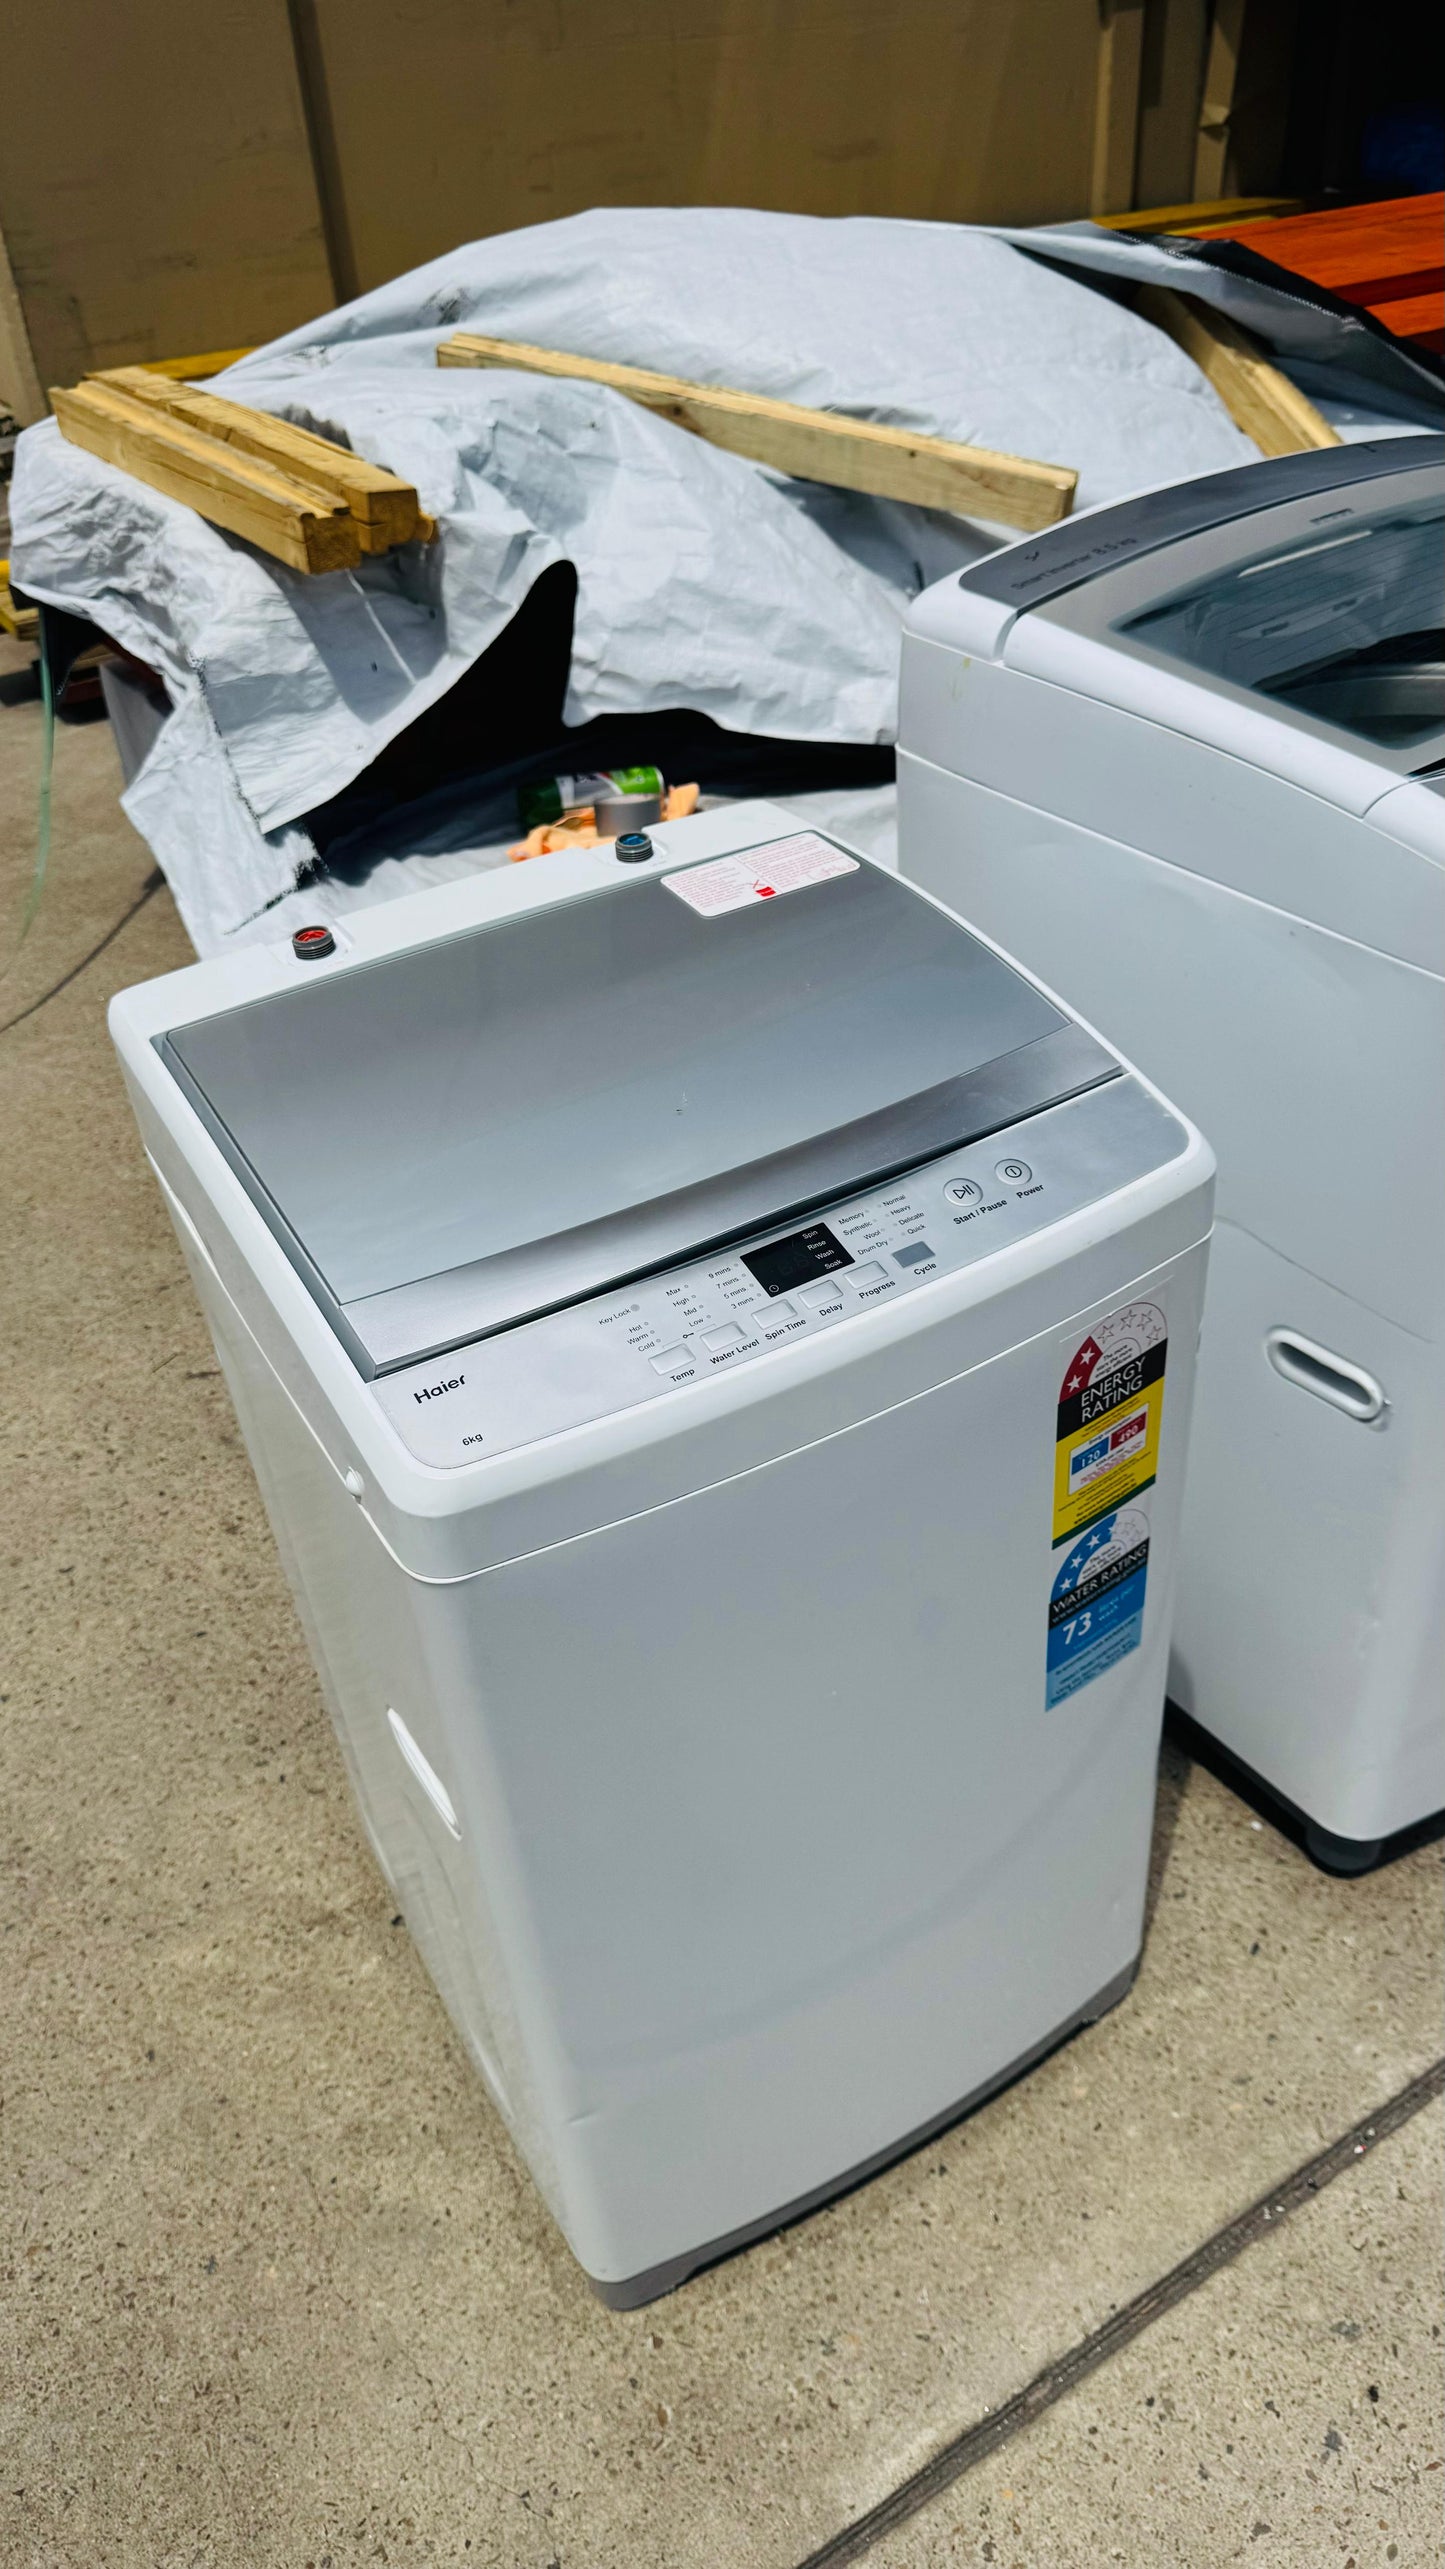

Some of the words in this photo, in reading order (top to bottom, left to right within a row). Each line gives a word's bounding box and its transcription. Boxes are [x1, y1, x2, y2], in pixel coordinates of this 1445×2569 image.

[1016, 1184, 1044, 1199] Power
[882, 1194, 906, 1207] Normal
[890, 1204, 911, 1216] Heavy
[953, 1212, 976, 1225] Start
[979, 1199, 1008, 1214] Pause
[838, 1211, 865, 1225] Memory
[898, 1212, 925, 1226] Delicate
[801, 1230, 818, 1240] Spin
[843, 1221, 872, 1236] Synthetic
[863, 1230, 881, 1240] Wool
[907, 1223, 926, 1235] Quick
[807, 1239, 827, 1251] Rinse
[857, 1244, 876, 1256] Drum
[875, 1239, 889, 1250] Dry
[814, 1249, 835, 1260] Wash
[824, 1259, 843, 1270] Soak
[913, 1262, 937, 1276] Cycle
[714, 1267, 731, 1277] mins
[666, 1287, 681, 1297] Max
[858, 1280, 896, 1299] Progress
[673, 1296, 689, 1307] High
[737, 1297, 754, 1307] mins
[599, 1315, 613, 1326] Key
[614, 1307, 631, 1320] Lock
[683, 1307, 697, 1317] Mid
[818, 1303, 844, 1317] Delay
[629, 1324, 642, 1334] Hot
[689, 1317, 704, 1328] Low
[764, 1327, 785, 1341] Spin
[784, 1317, 807, 1333] Time
[627, 1332, 649, 1345] Warm
[638, 1341, 655, 1352] Cold
[709, 1349, 735, 1365] Water
[736, 1339, 760, 1354] Level
[670, 1368, 695, 1383] Temp
[1081, 1356, 1146, 1407] ENERGY
[413, 1374, 466, 1404] Haier
[1081, 1375, 1143, 1423] RATING
[462, 1433, 483, 1446] 6kg
[1081, 1449, 1101, 1468] 120
[1053, 1579, 1098, 1613] WATER
[1100, 1543, 1147, 1583] RATING
[1062, 1611, 1092, 1645] 73
